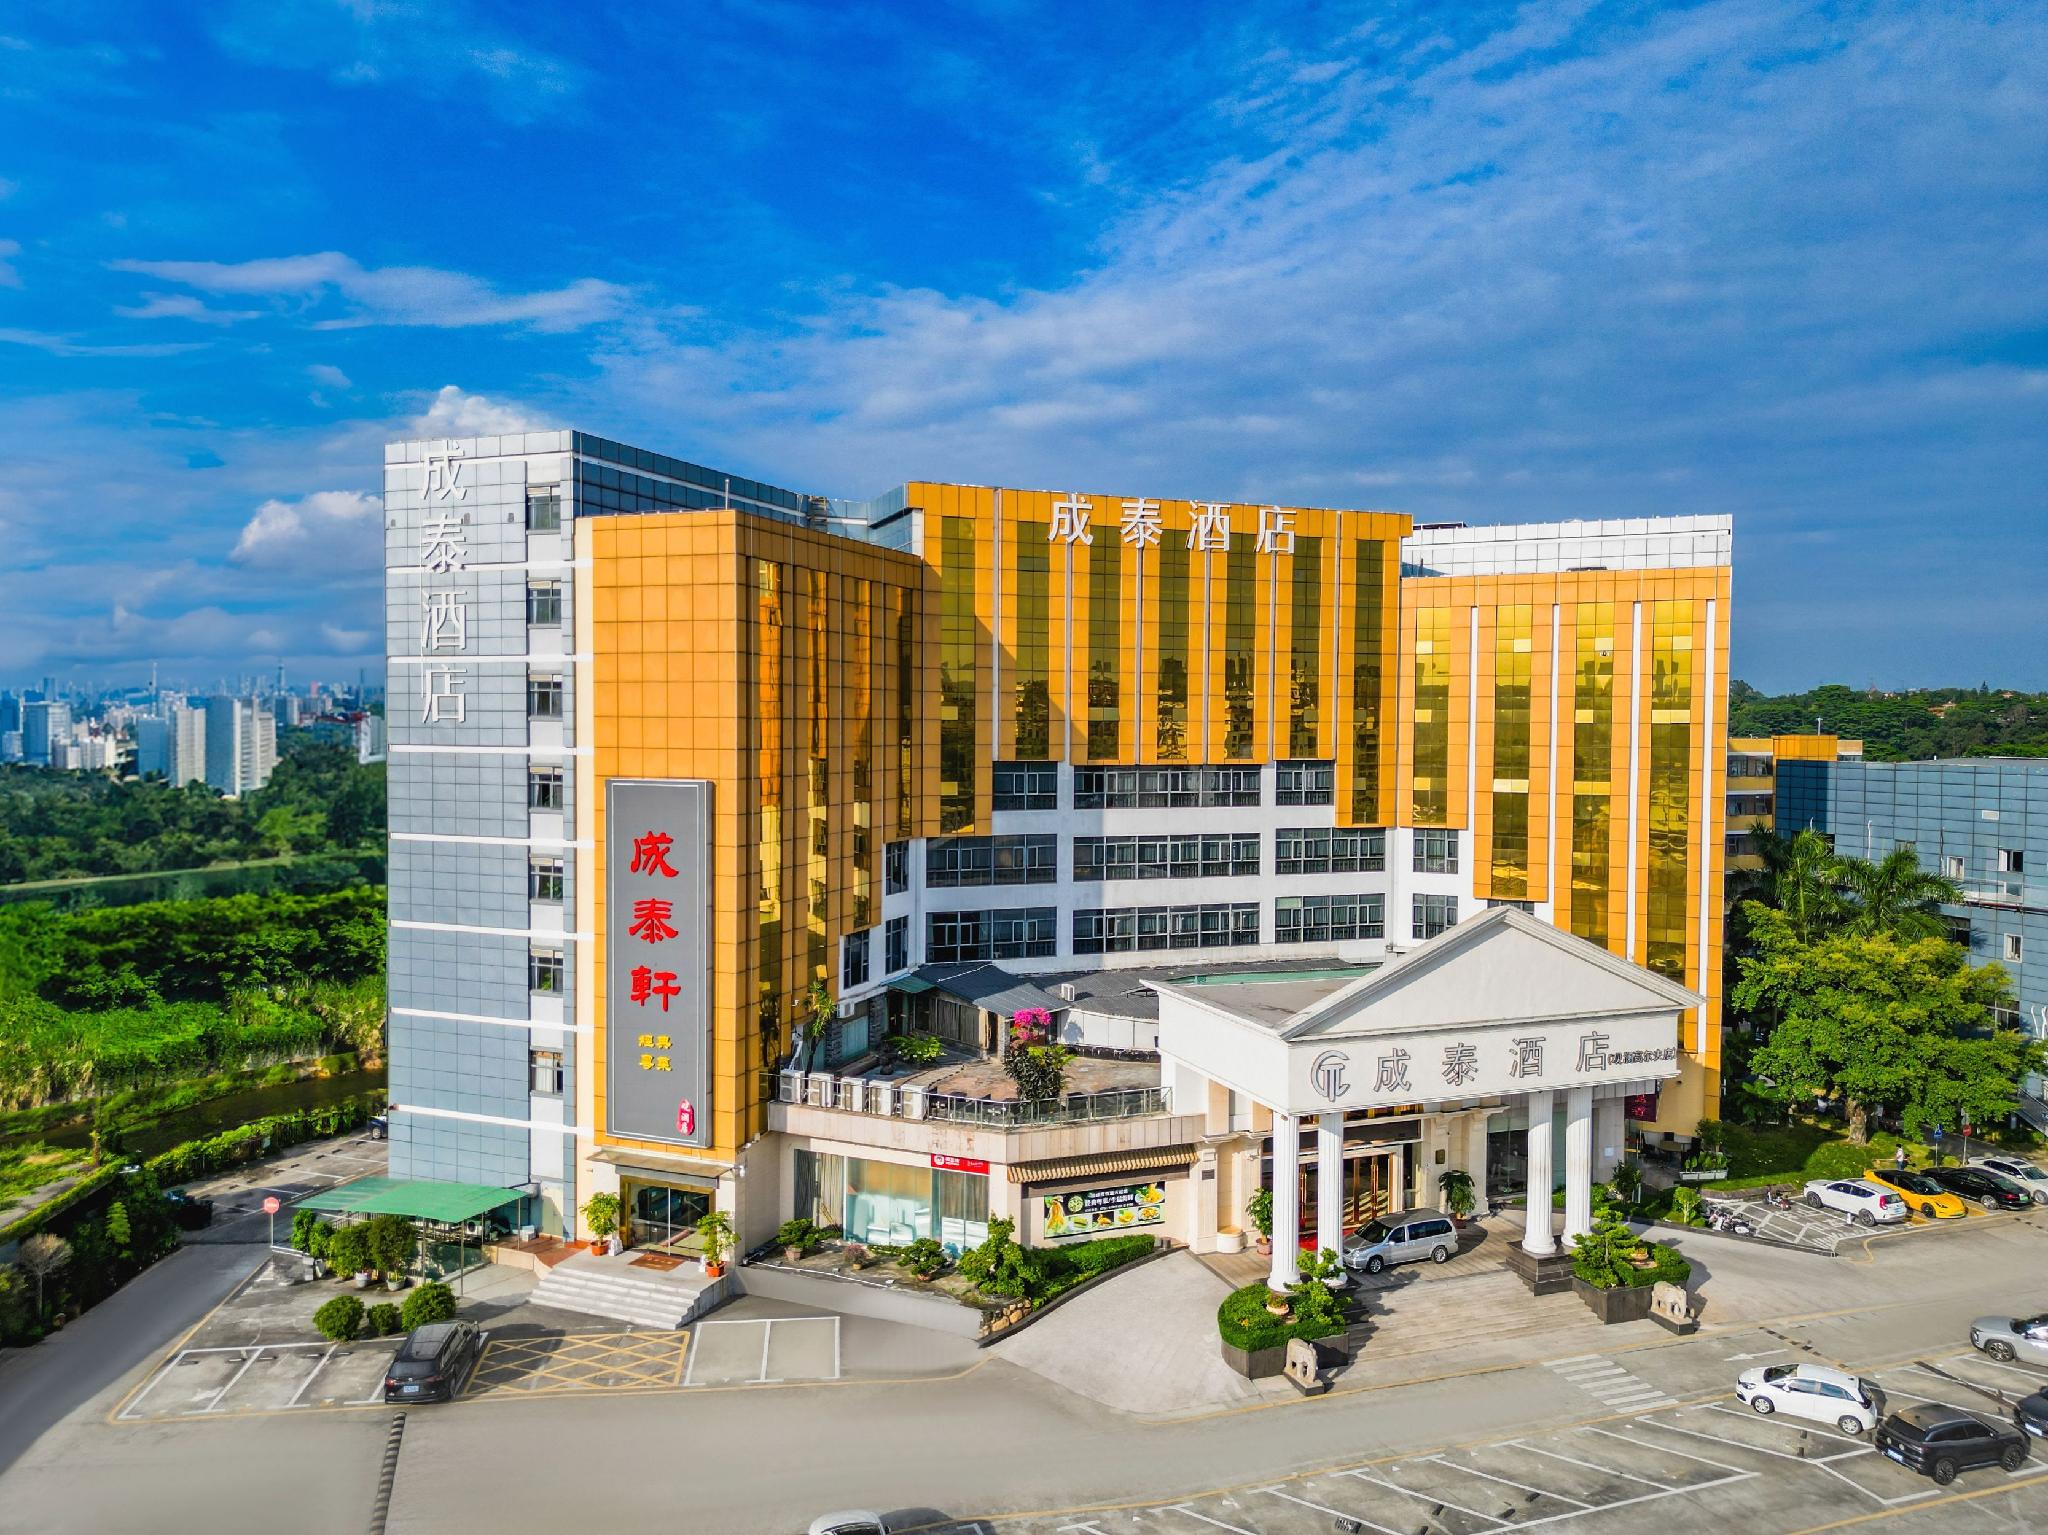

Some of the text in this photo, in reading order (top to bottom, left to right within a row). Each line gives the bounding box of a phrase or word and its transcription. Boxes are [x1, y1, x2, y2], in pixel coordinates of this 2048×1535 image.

[1048, 493, 1297, 554] 成泰酒店
[421, 439, 467, 724] 成泰酒店
[1372, 1031, 1610, 1093] 成泰酒店
